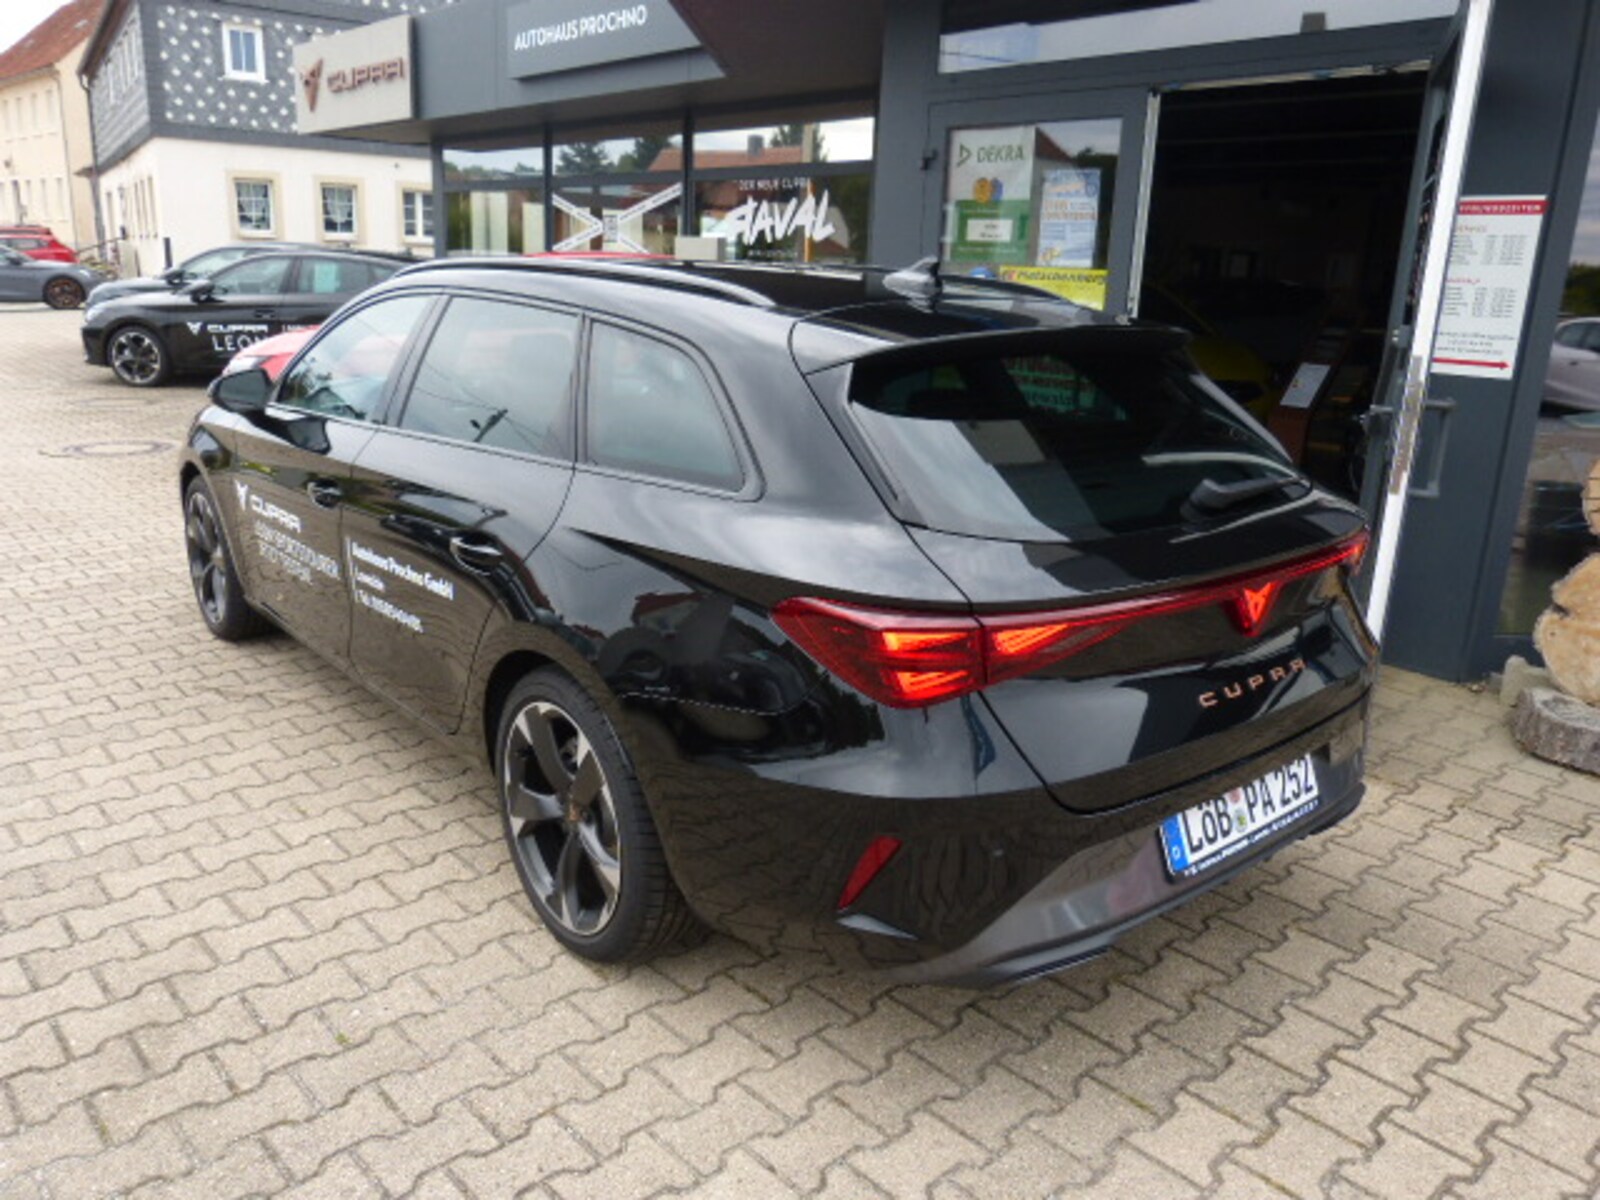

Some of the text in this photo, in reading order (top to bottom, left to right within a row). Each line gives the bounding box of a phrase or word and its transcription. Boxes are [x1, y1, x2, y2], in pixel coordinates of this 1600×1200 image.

[514, 4, 647, 51] AUTOHAUS PROCHNO
[326, 57, 405, 94] CUPRA
[976, 144, 1025, 164] DEKRA
[207, 324, 268, 333] CUPRA
[1198, 657, 1307, 708] CUPRA
[1183, 796, 1234, 854] LÖB
[1243, 773, 1276, 823] PA
[1274, 758, 1314, 806] 252
